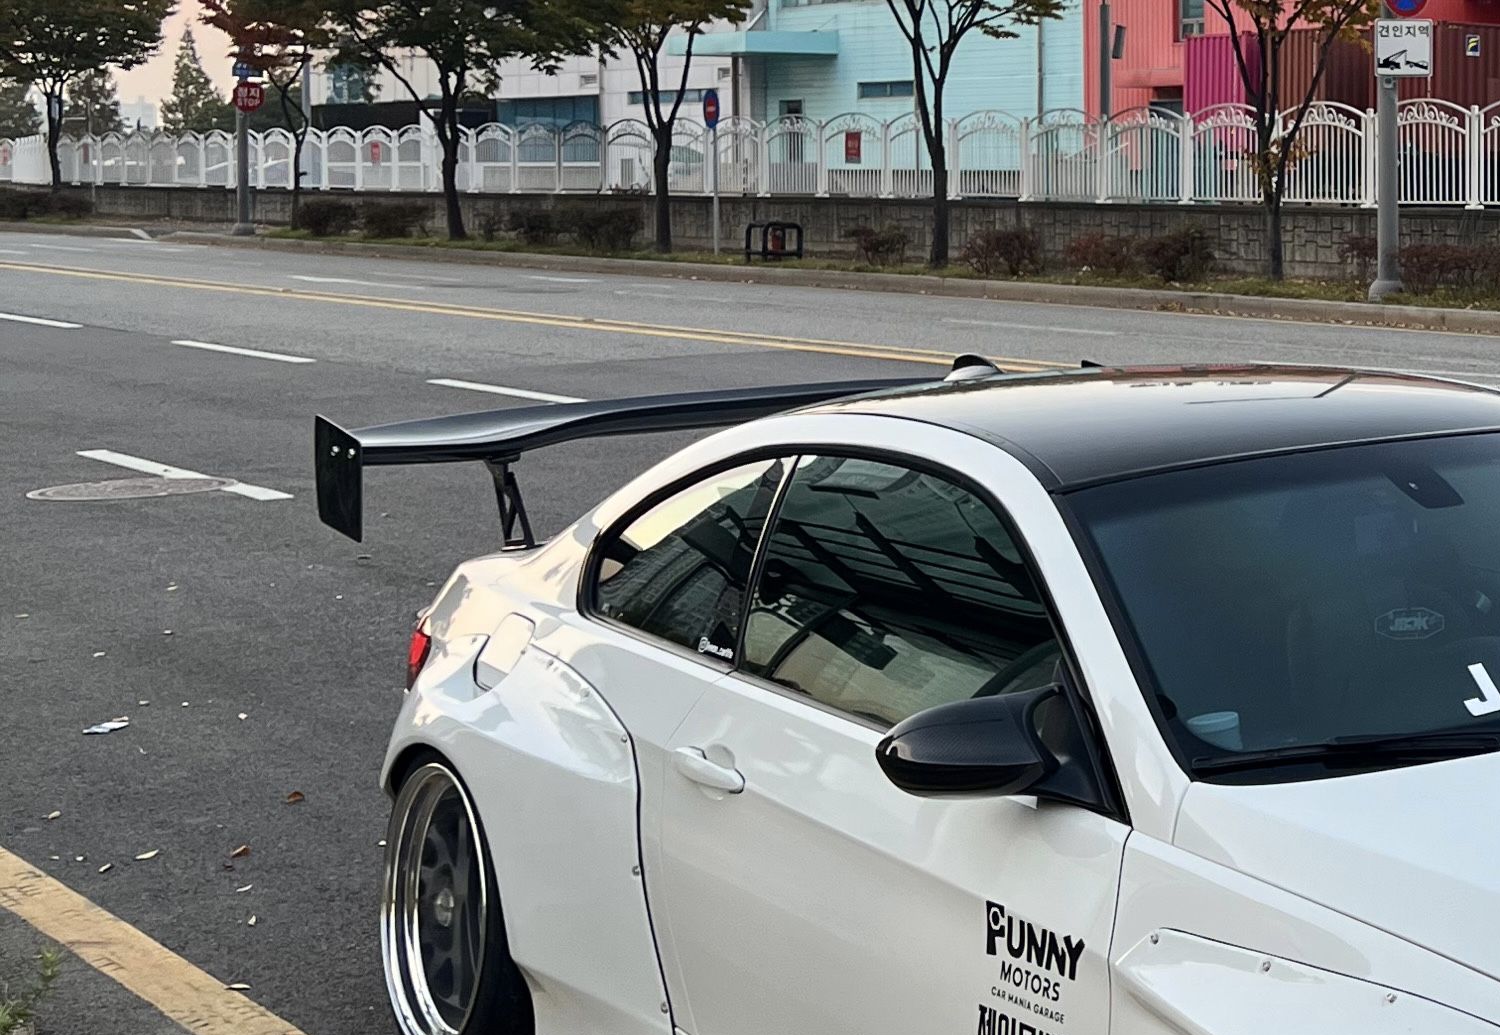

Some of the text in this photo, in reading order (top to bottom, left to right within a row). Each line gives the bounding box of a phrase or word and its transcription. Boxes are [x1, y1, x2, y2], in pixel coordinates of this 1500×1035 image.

[1378, 24, 1431, 38] 견인지역
[237, 97, 261, 107] STOP
[986, 900, 1086, 981] FUNNY
[1000, 960, 1061, 1002] MOTORS
[991, 986, 1065, 1025] CAR MANIA GARAGE
